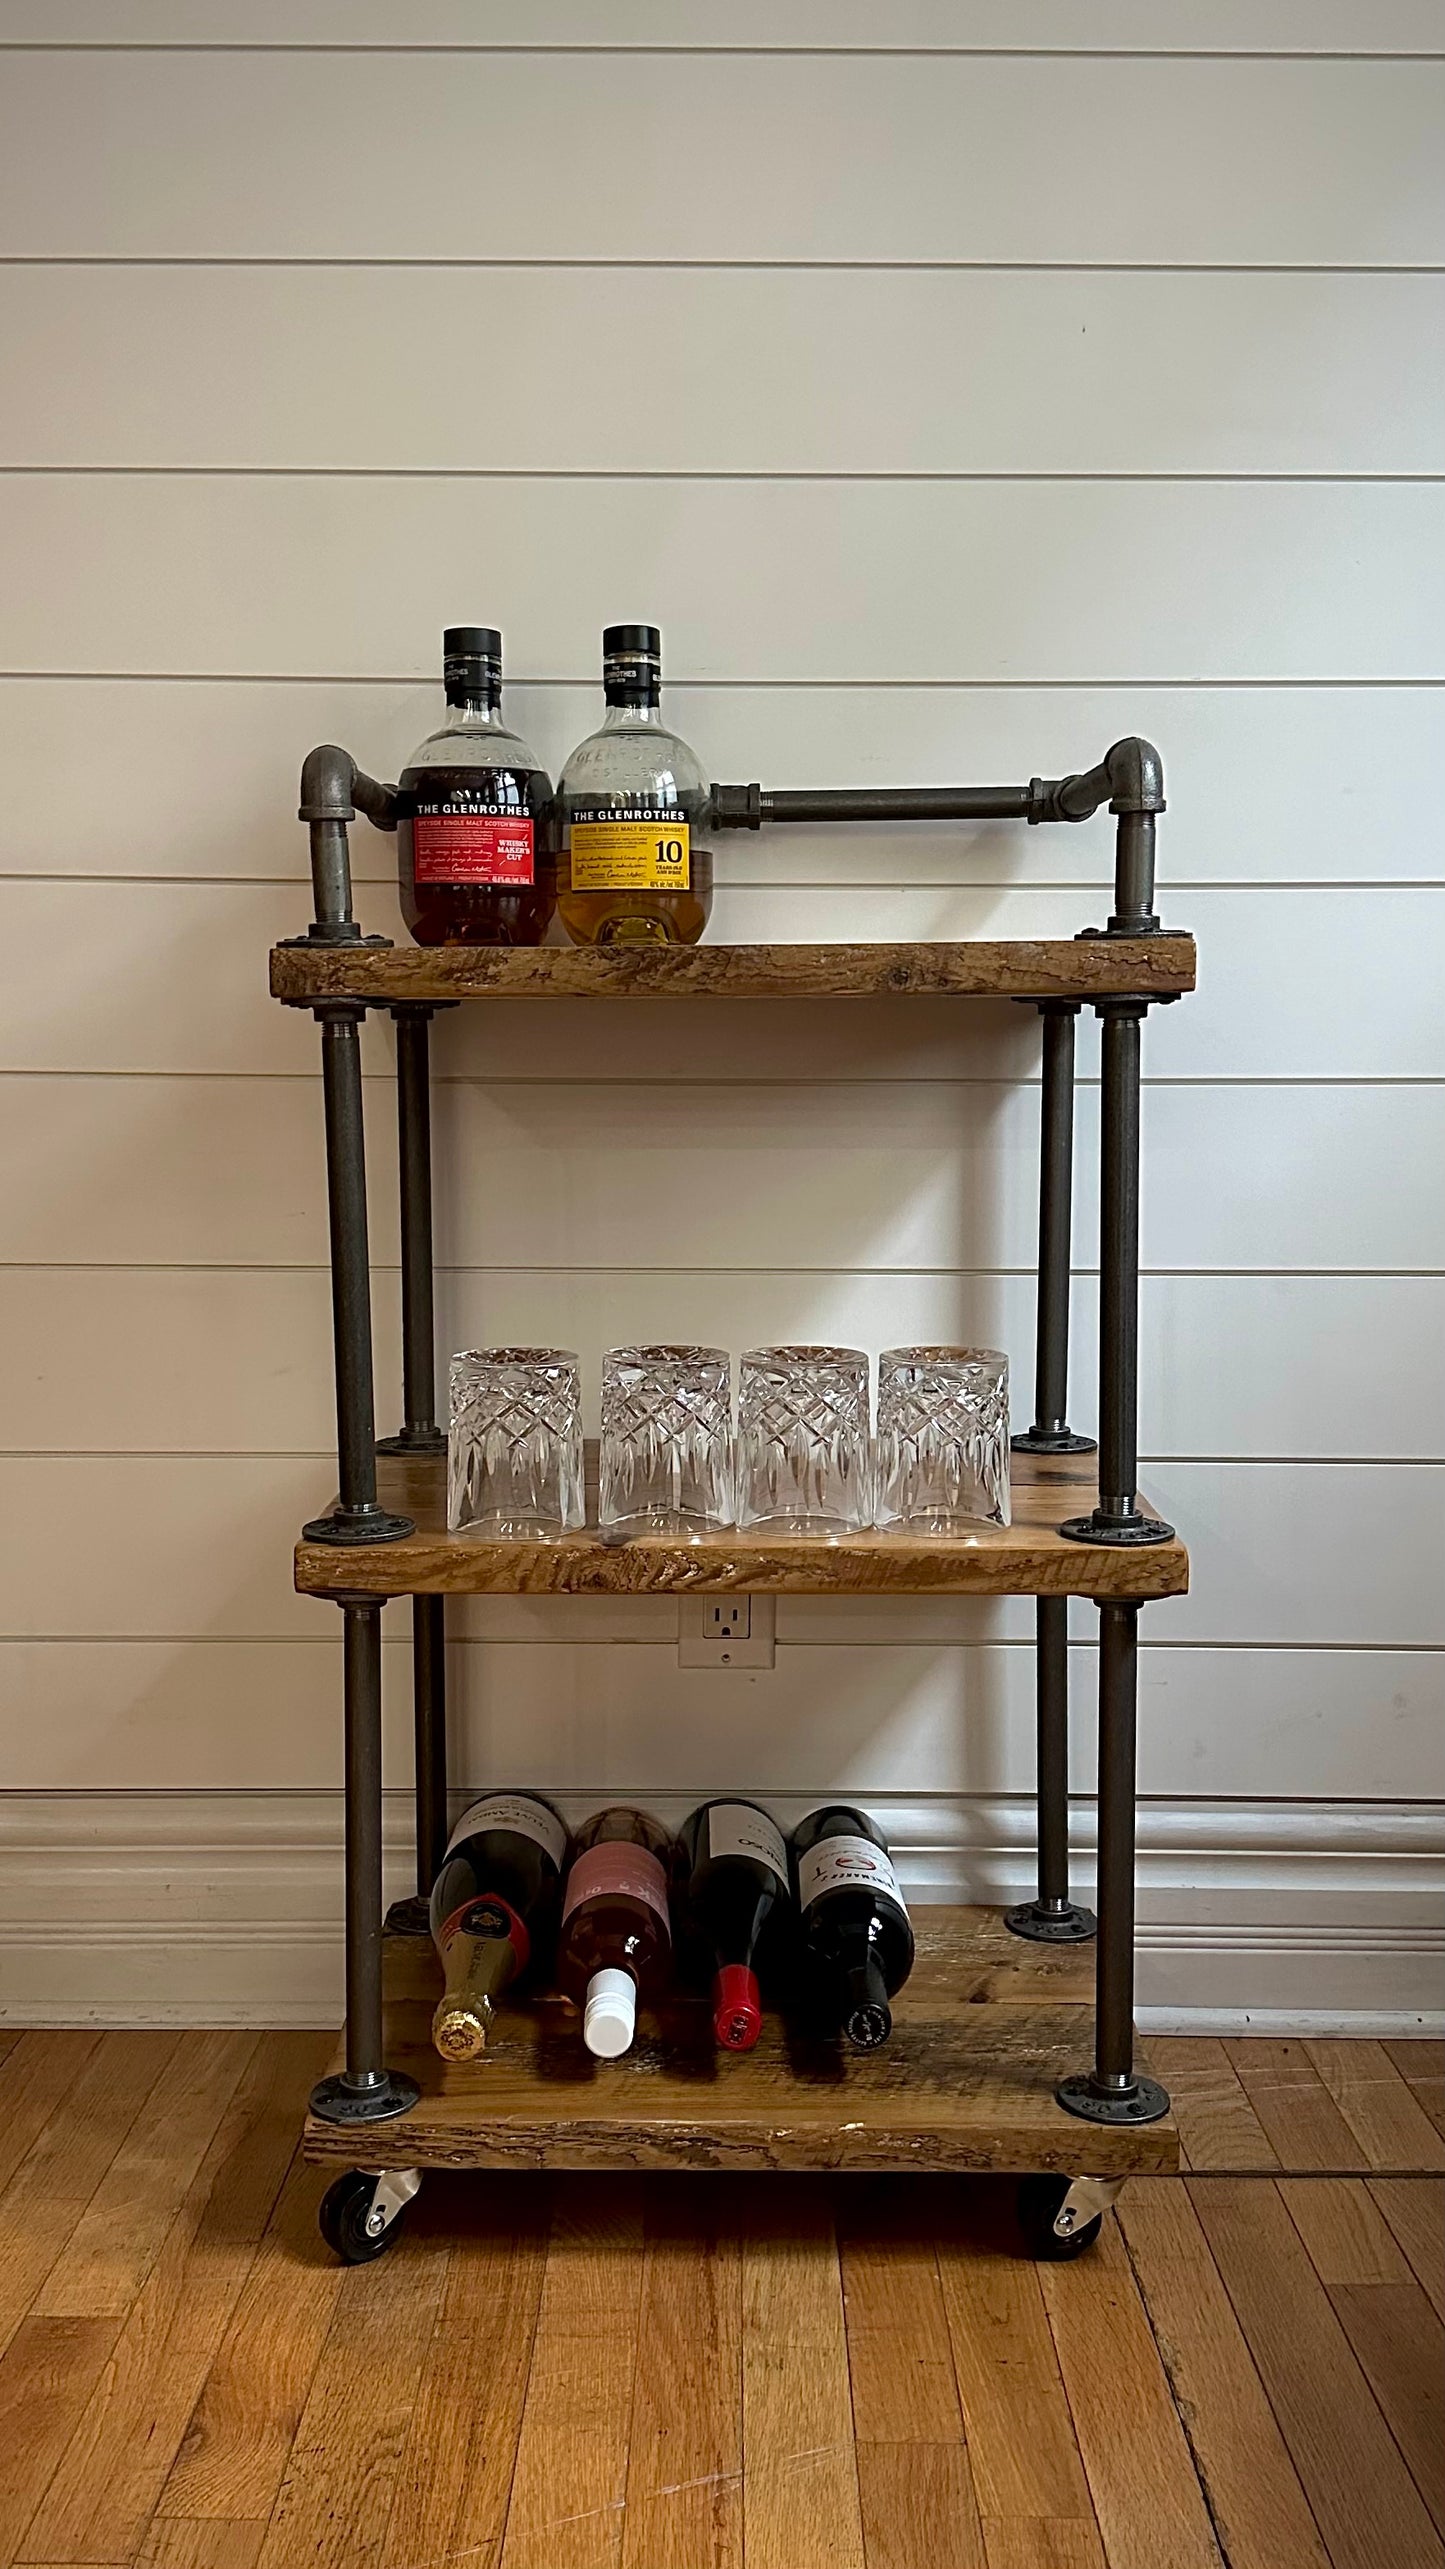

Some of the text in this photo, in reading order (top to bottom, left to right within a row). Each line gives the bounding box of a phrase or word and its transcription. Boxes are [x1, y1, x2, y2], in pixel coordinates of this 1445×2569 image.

[417, 804, 530, 817] THE GLENROTHES
[574, 810, 685, 821] THE GLENROTHES
[499, 839, 529, 848] WHISKY
[497, 847, 531, 855] MAKER'S
[655, 840, 683, 863] 10
